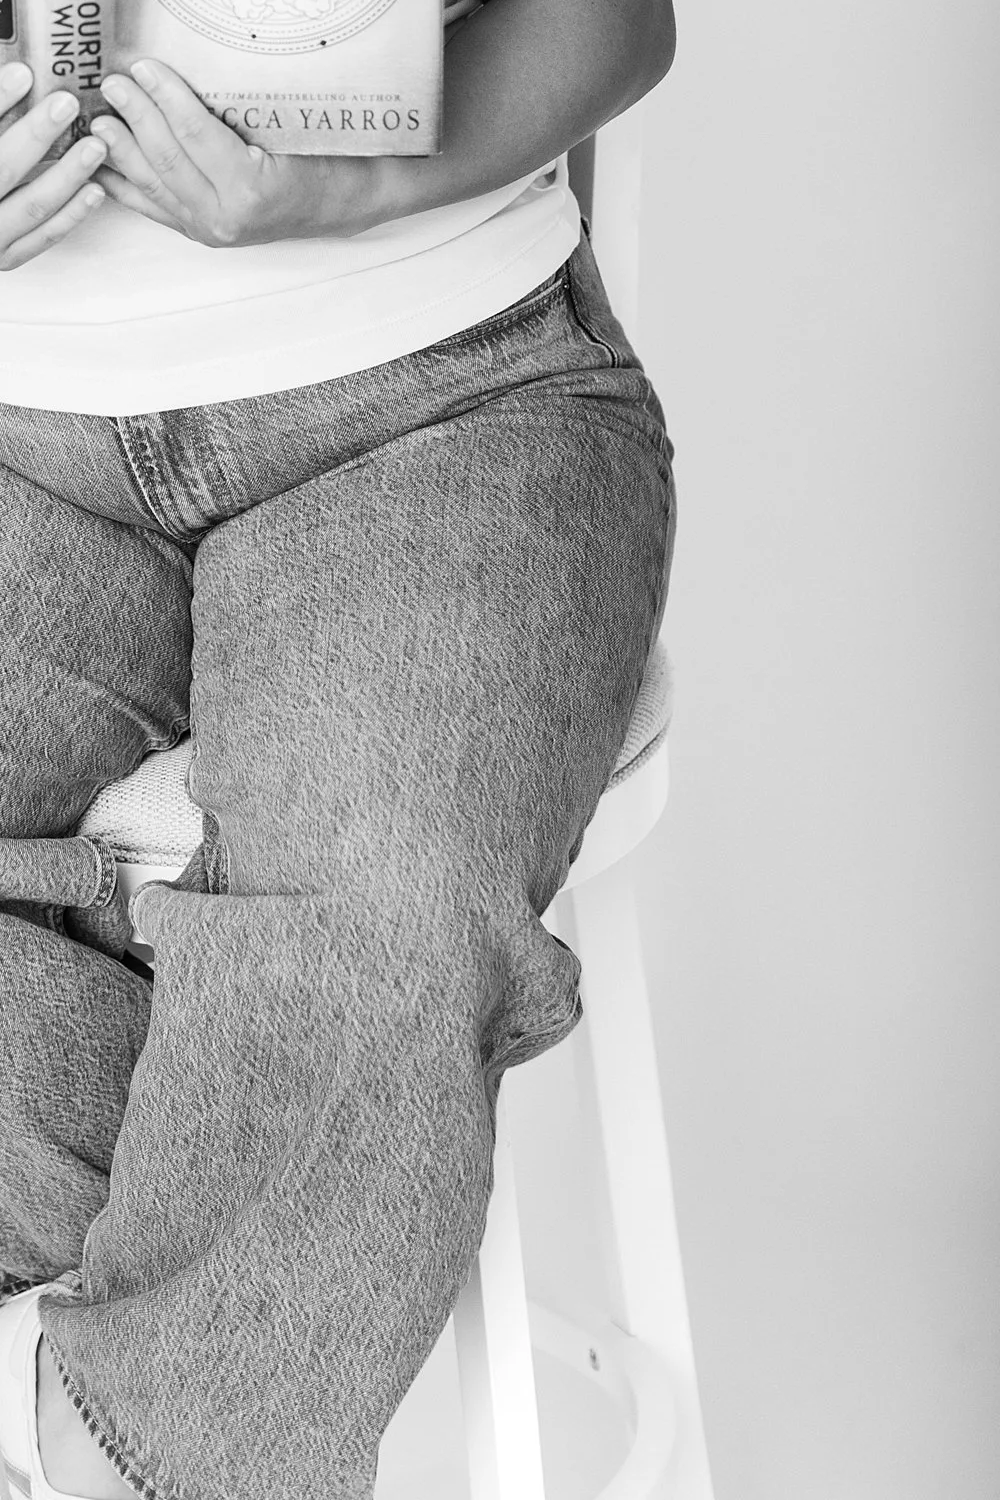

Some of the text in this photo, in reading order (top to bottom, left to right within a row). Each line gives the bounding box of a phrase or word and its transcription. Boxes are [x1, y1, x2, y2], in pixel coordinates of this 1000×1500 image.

[51, 4, 75, 77] WING
[265, 93, 346, 102] BESTSELLING
[351, 93, 401, 102] AUTHOR
[300, 108, 420, 131] YARROS
